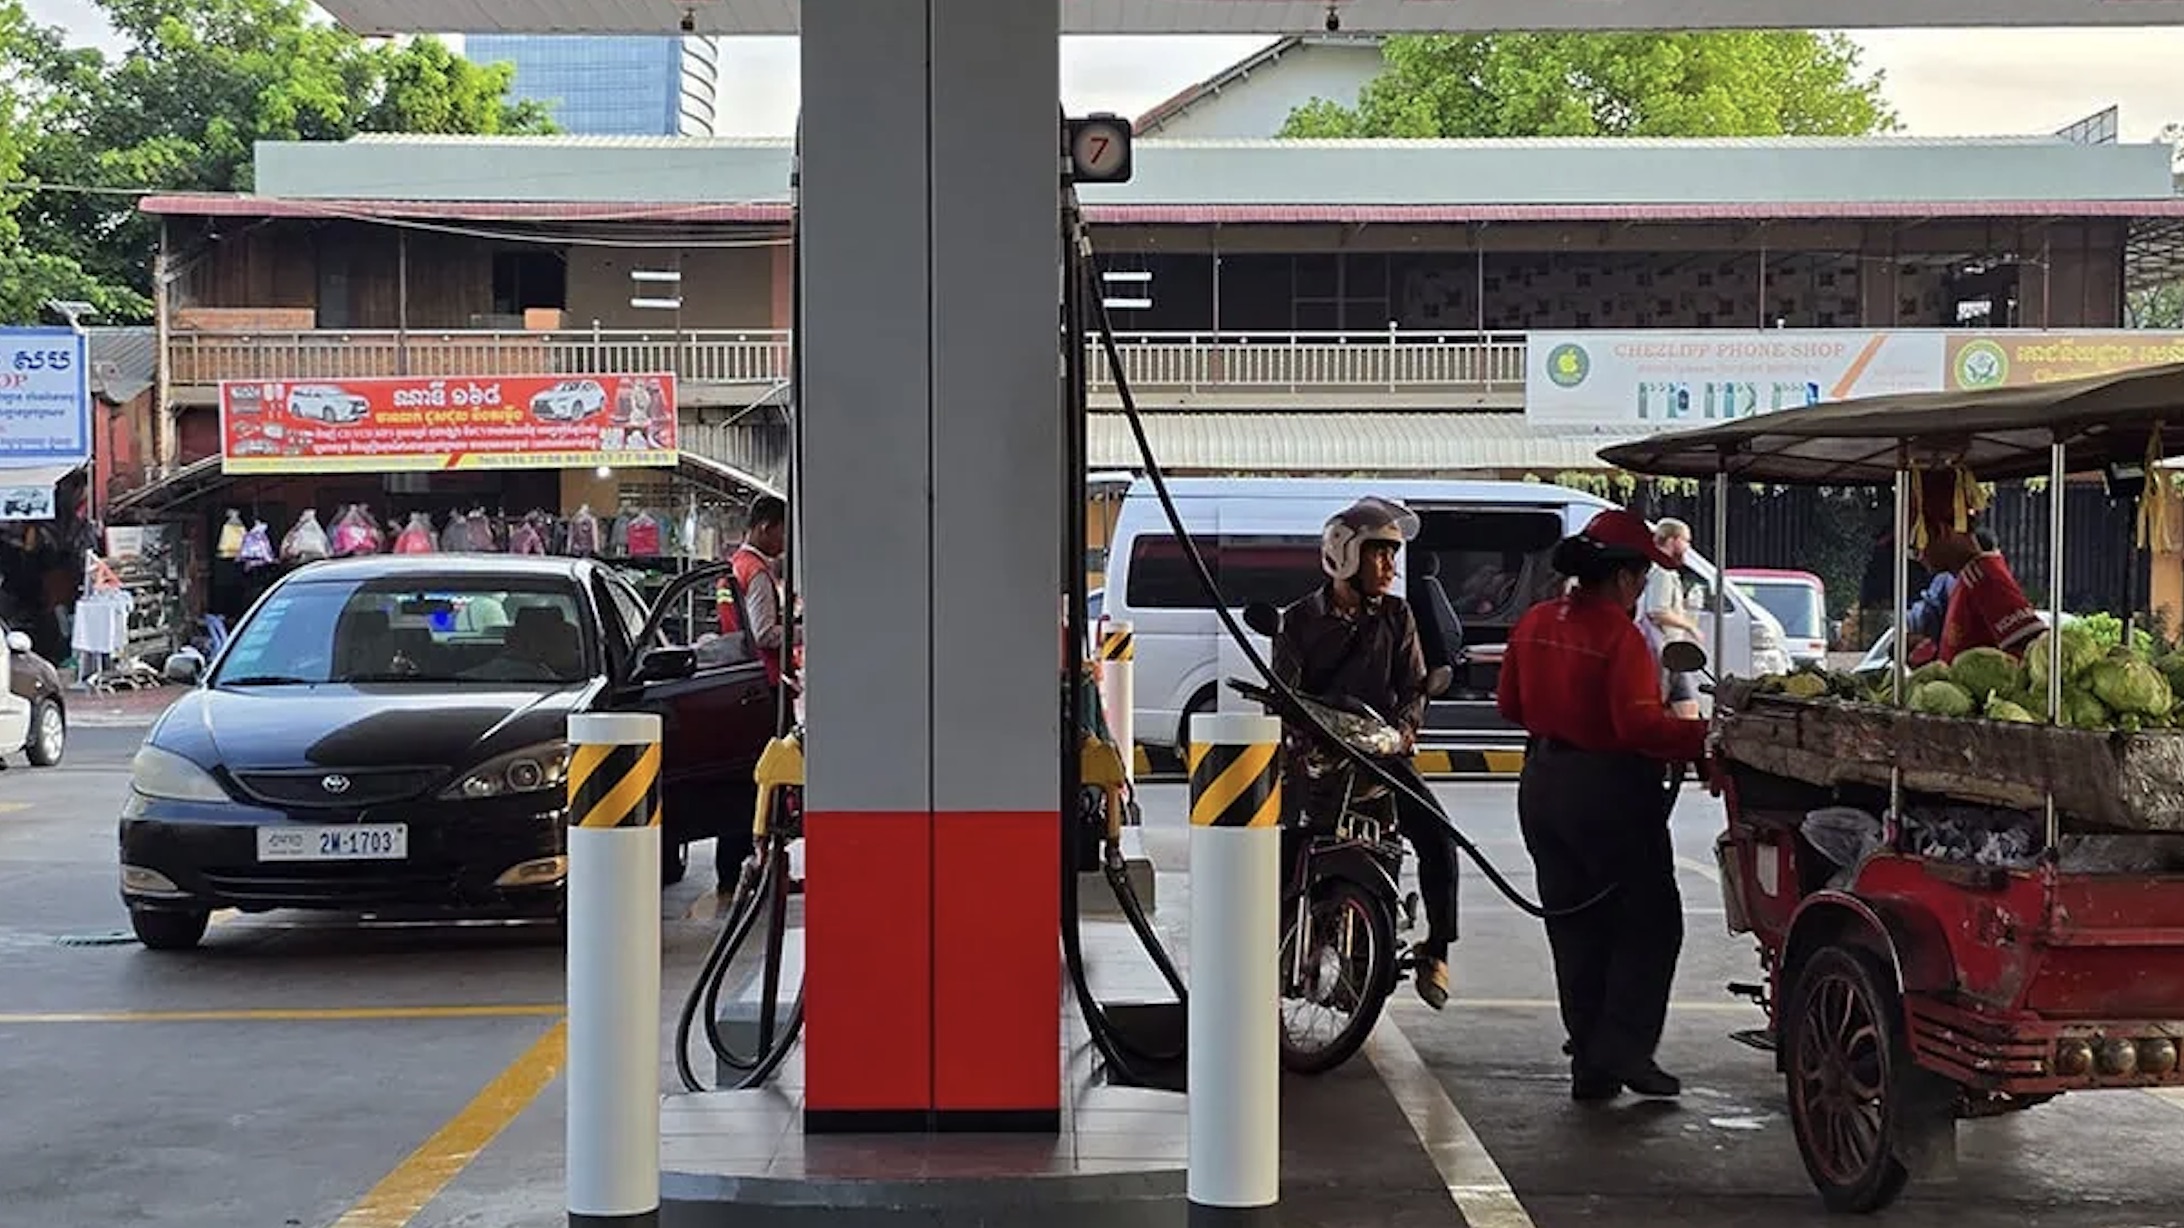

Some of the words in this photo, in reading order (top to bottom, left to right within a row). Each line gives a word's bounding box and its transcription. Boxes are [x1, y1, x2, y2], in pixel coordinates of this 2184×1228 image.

[1091, 137, 1108, 163] 7
[1716, 343, 1786, 357] PHONE
[1790, 342, 1845, 357] SHOP
